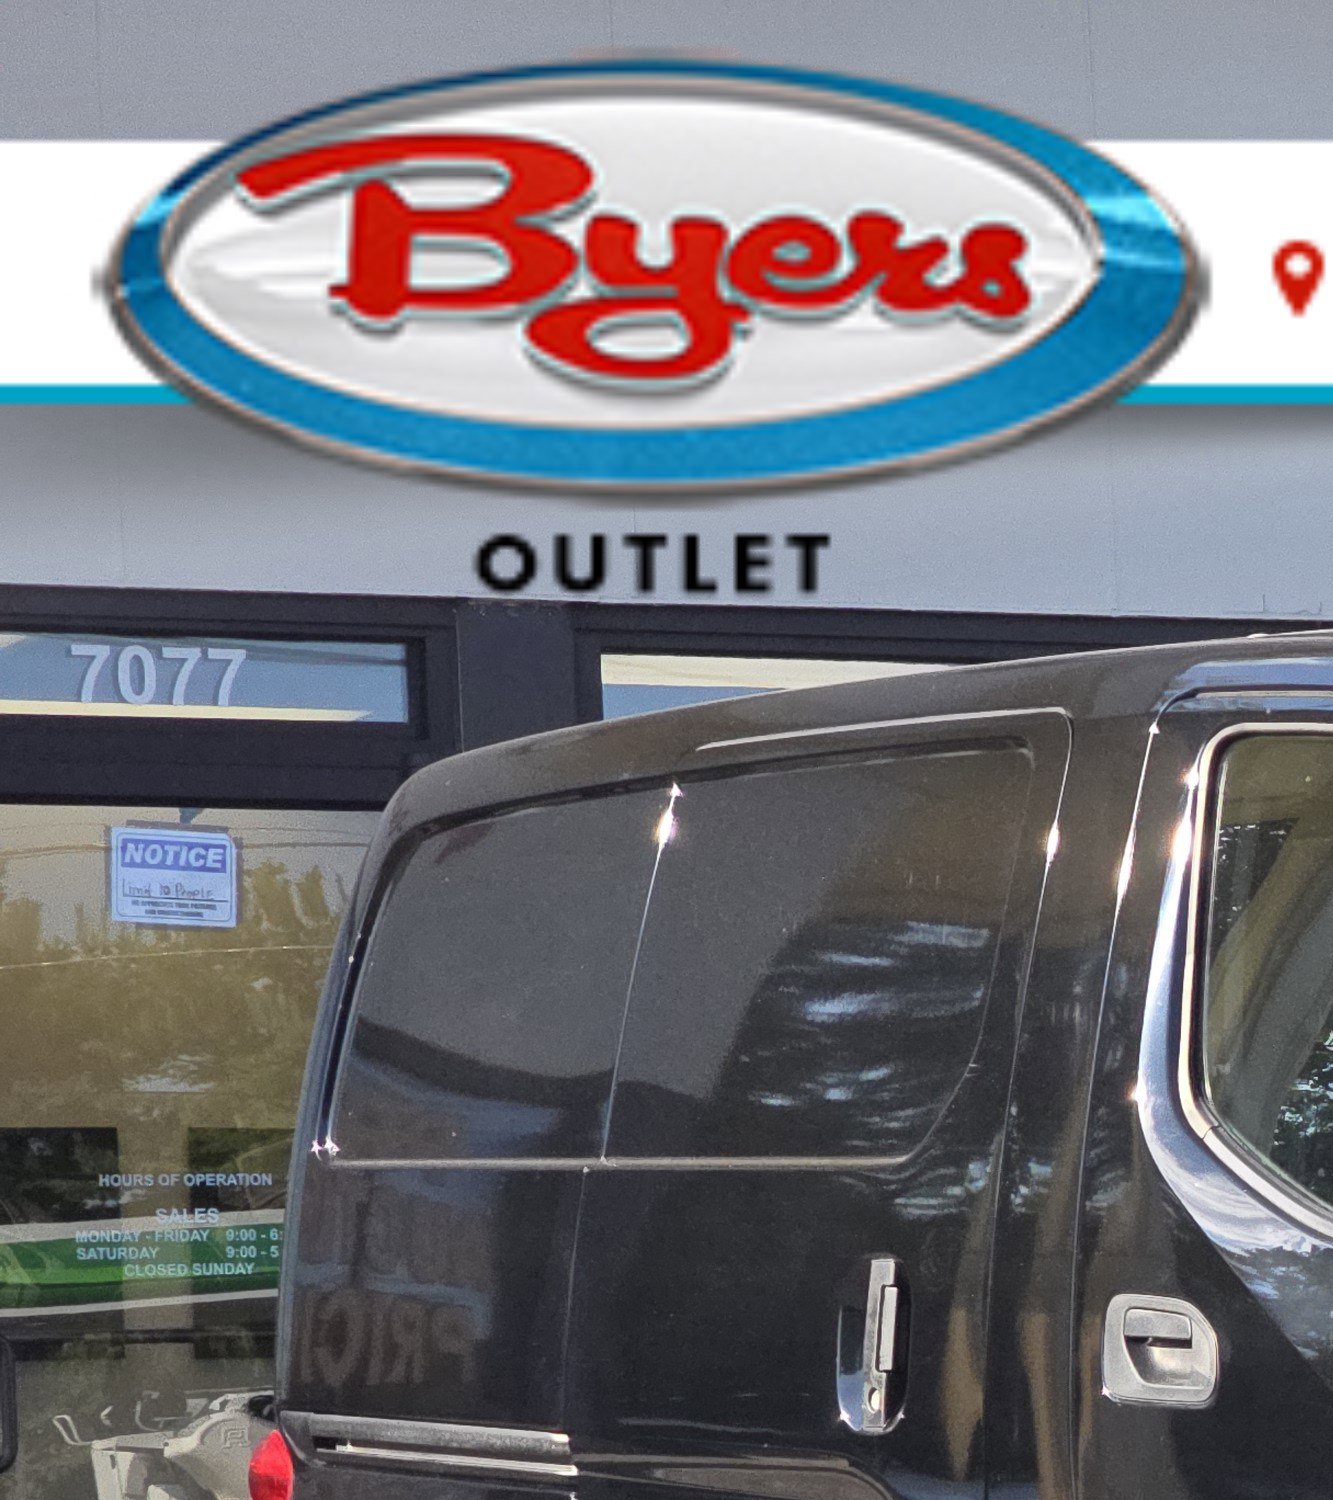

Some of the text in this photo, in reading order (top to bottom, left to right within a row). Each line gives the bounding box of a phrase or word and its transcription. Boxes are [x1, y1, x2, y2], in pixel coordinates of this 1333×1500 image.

[71, 645, 247, 706] 7077
[123, 842, 224, 869] NOTICE
[99, 1172, 273, 1187] HOURS OF OPERATION
[155, 1208, 220, 1224] SALES
[75, 1230, 141, 1243] MONDAY
[155, 1229, 210, 1242] FRIDAY
[225, 1228, 257, 1241] 9:00
[76, 1247, 159, 1260] SATURDAY
[225, 1246, 257, 1259] 9:00
[123, 1262, 255, 1277] CLOSED SUNDAY
